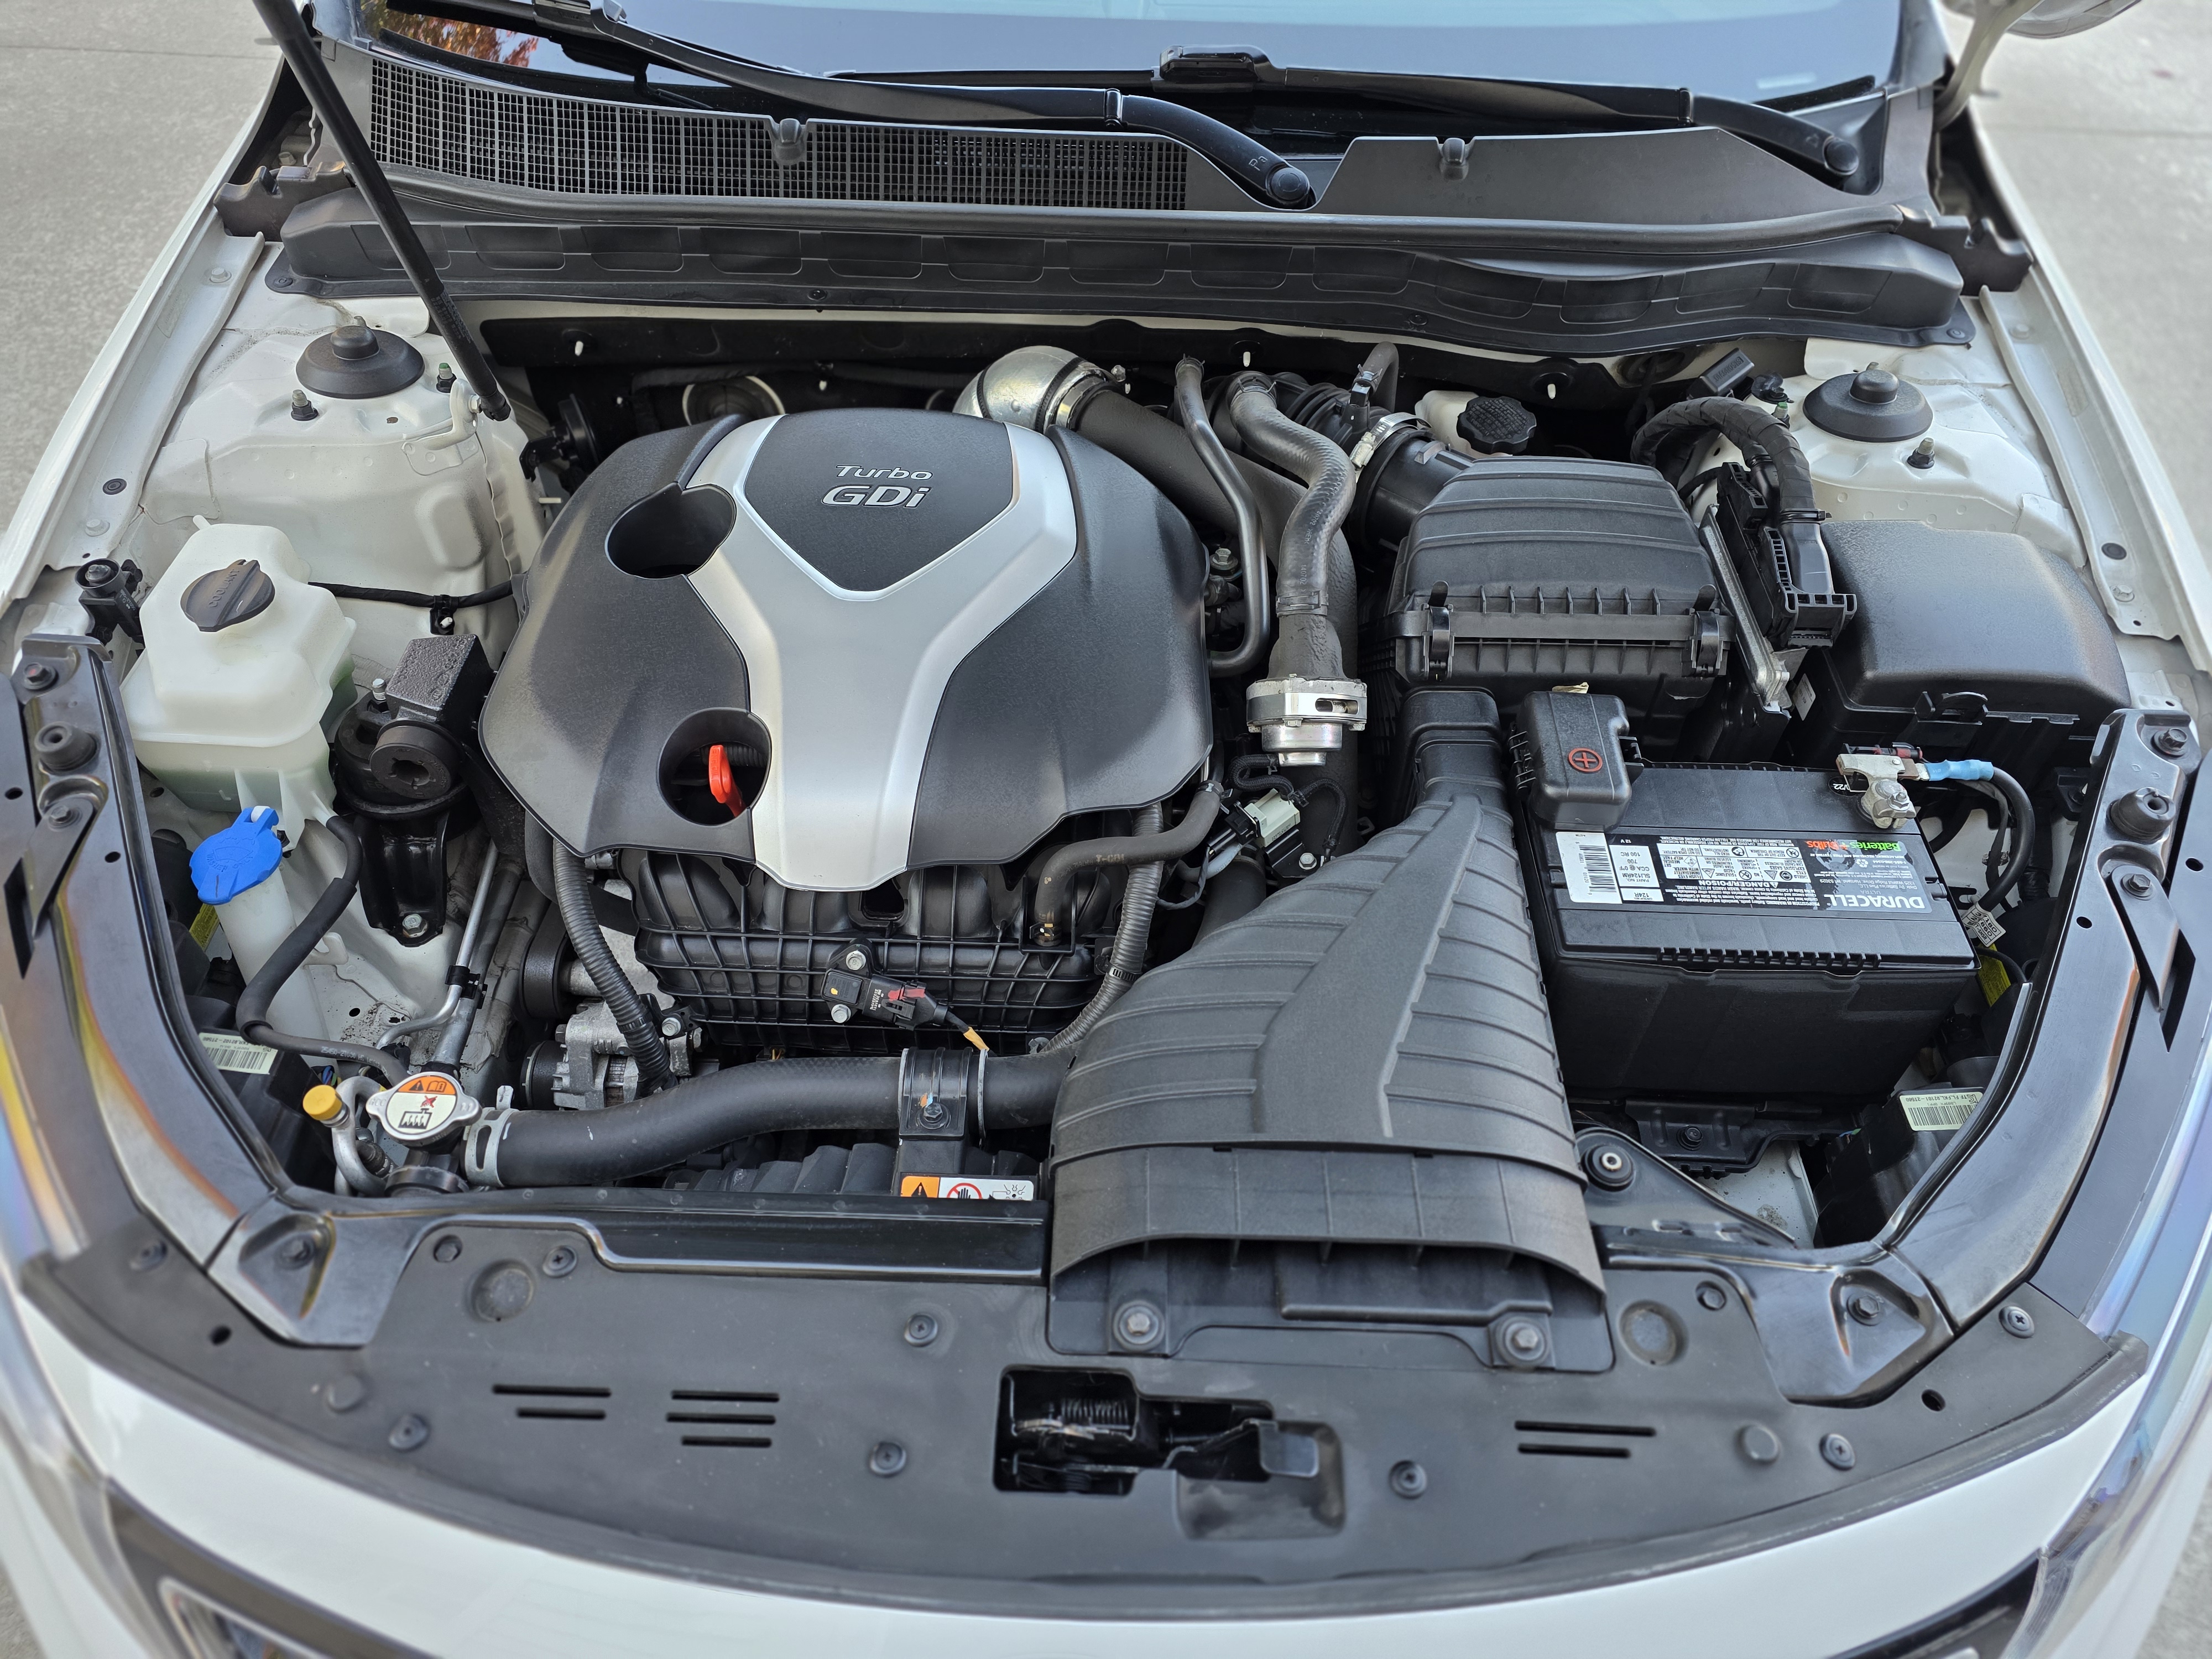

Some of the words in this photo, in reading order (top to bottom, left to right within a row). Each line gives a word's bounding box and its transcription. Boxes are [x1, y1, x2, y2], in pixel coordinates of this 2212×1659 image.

[836, 465, 933, 480] Turbo
[821, 484, 931, 508] GDi
[208, 567, 241, 609] COOLANT
[205, 852, 229, 874] WASHER
[232, 853, 255, 871] ONLY
[1970, 915, 1992, 937] 2T860
[1975, 911, 1997, 933] 37180
